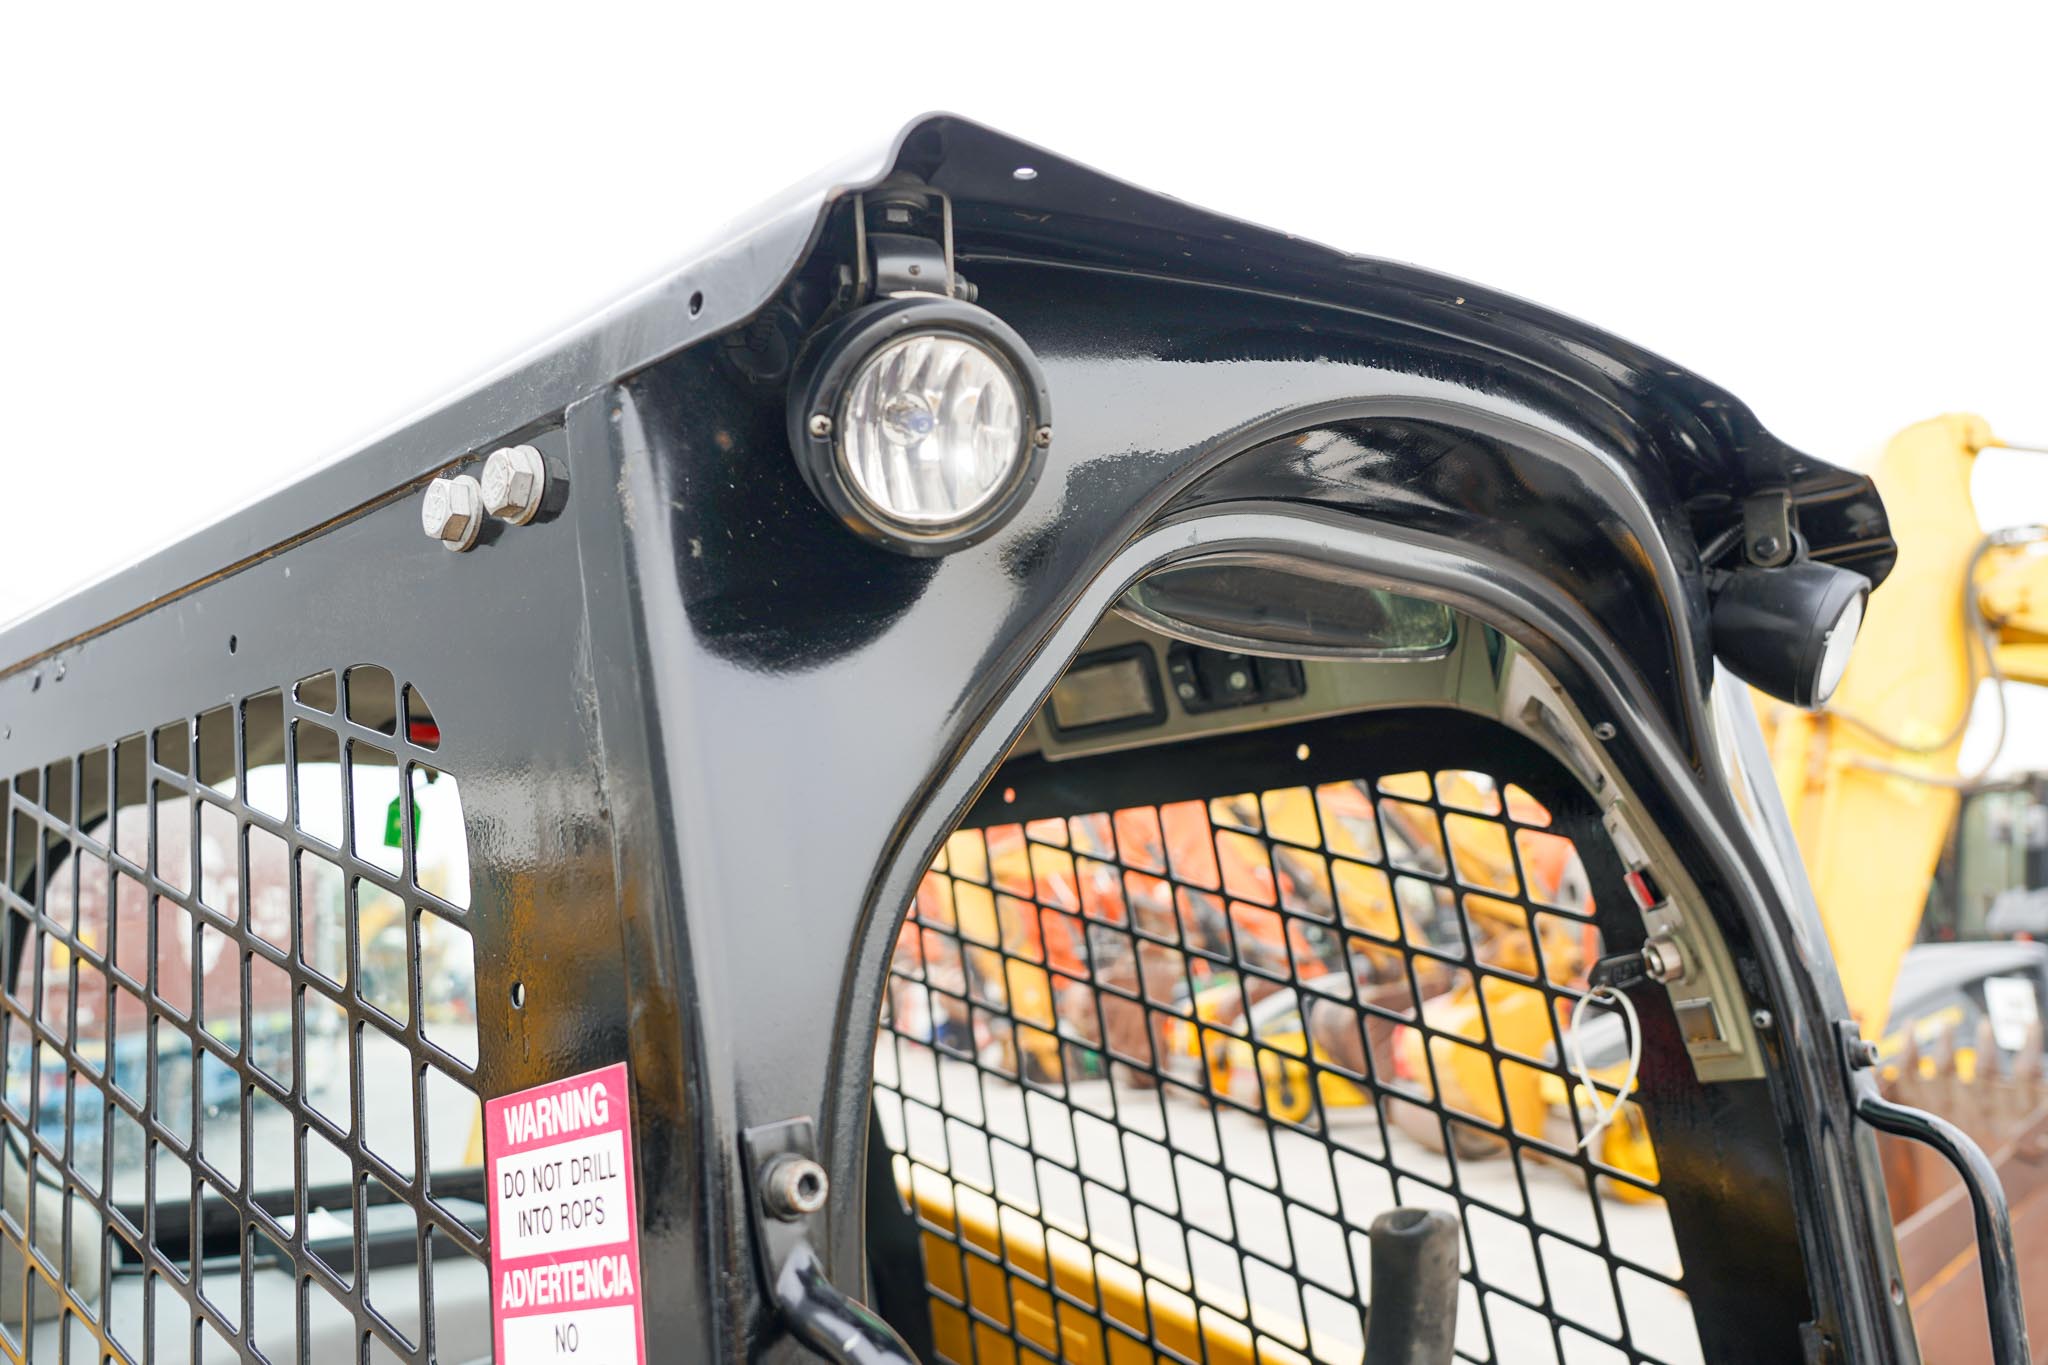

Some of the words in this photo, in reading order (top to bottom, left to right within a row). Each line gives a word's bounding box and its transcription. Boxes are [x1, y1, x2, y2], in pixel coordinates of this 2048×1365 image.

[503, 1082, 609, 1145] WARNING
[503, 1169, 525, 1200] DO
[532, 1162, 563, 1195] NOT
[571, 1151, 617, 1186] DRILL
[518, 1205, 553, 1238] INTO
[561, 1196, 605, 1231] ROPS
[501, 1254, 634, 1310] ADVERTENCIA
[555, 1323, 579, 1354] NO
